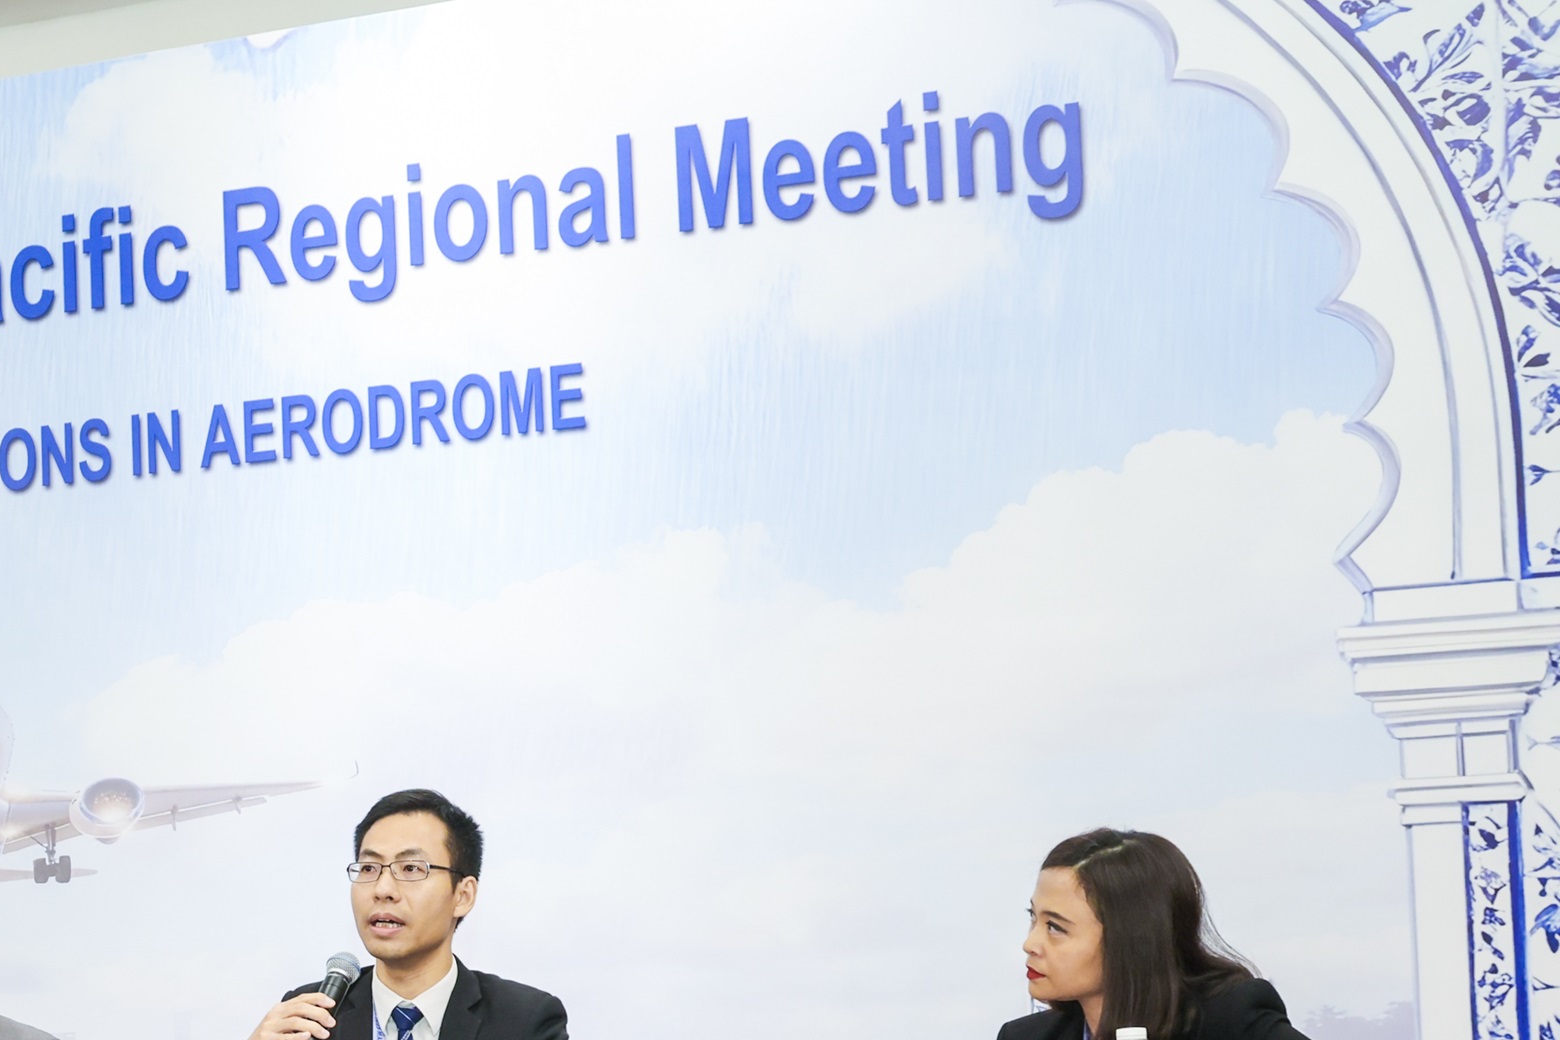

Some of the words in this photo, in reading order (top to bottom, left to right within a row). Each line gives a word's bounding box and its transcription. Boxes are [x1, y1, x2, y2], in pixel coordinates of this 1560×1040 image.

[222, 132, 637, 305] Regional
[674, 90, 1085, 221] Meeting
[130, 408, 183, 478] IN
[200, 362, 588, 471] AERODROME
